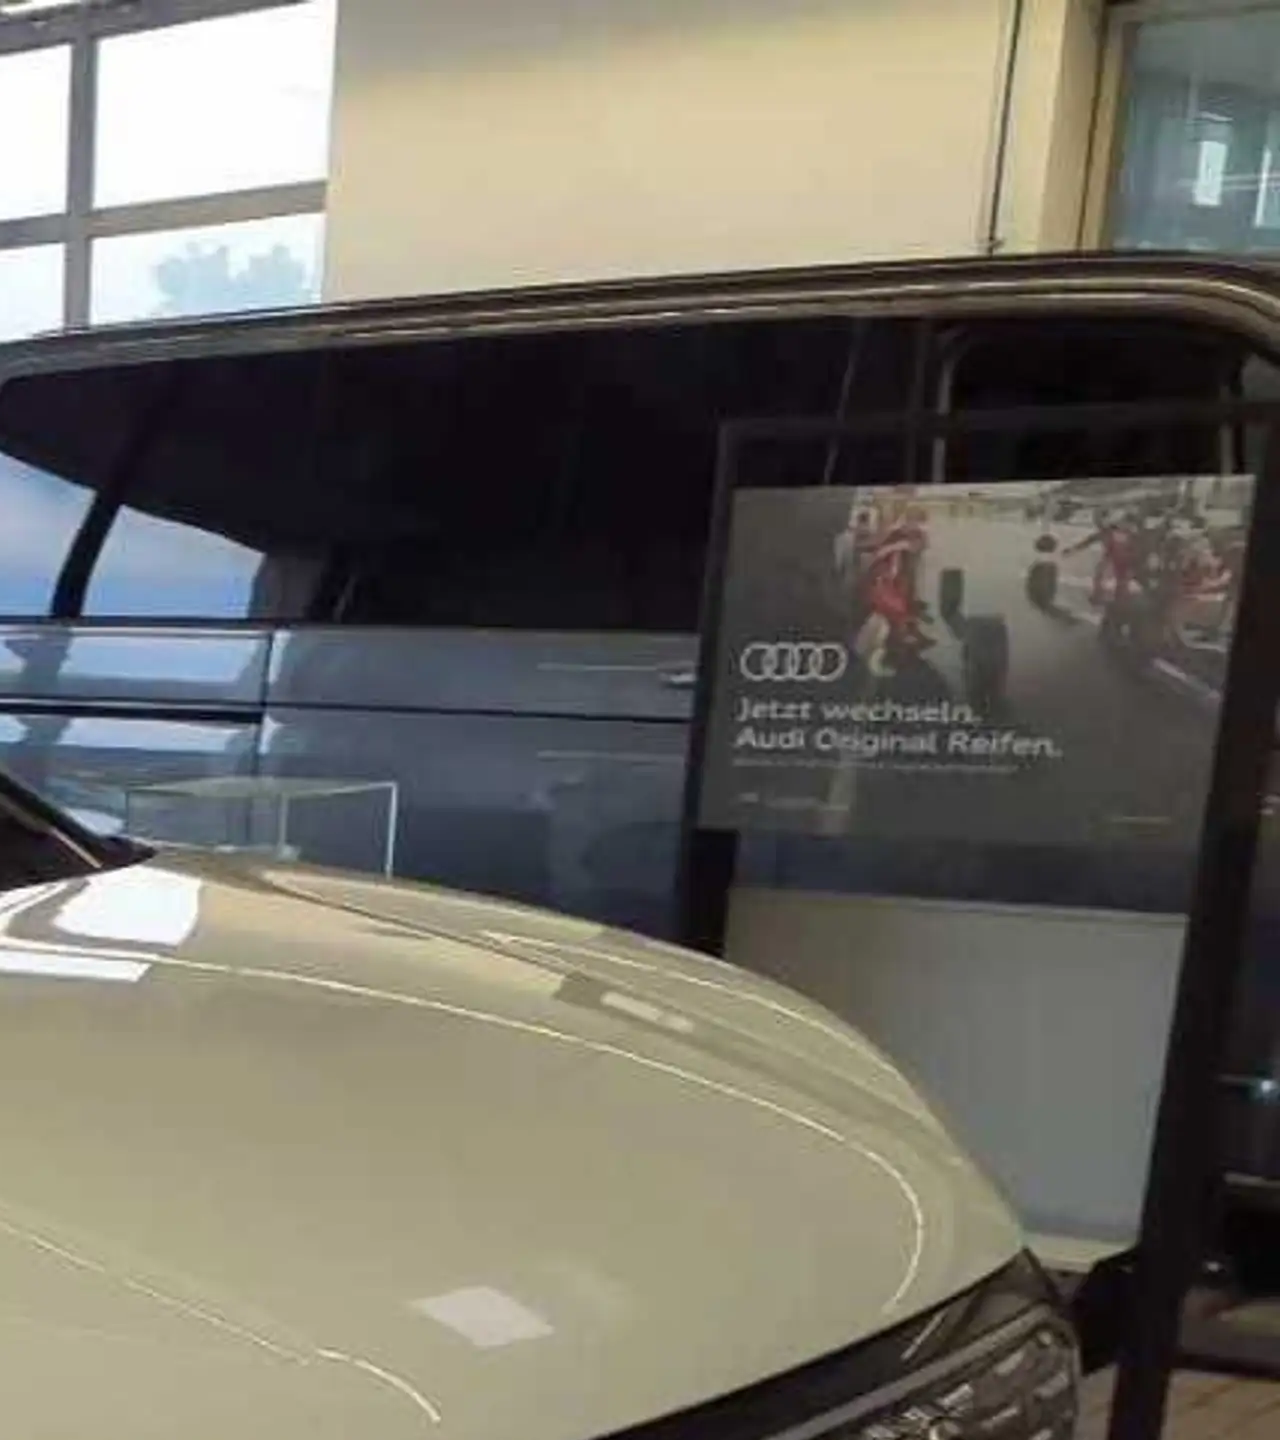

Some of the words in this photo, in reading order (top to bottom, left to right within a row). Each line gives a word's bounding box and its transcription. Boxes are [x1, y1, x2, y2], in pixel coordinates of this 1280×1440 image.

[736, 698, 811, 721] Jetzt
[820, 700, 982, 725] wechseln.
[733, 727, 805, 749] Audi
[814, 728, 939, 757] Original
[947, 731, 1064, 758] Reifen.
